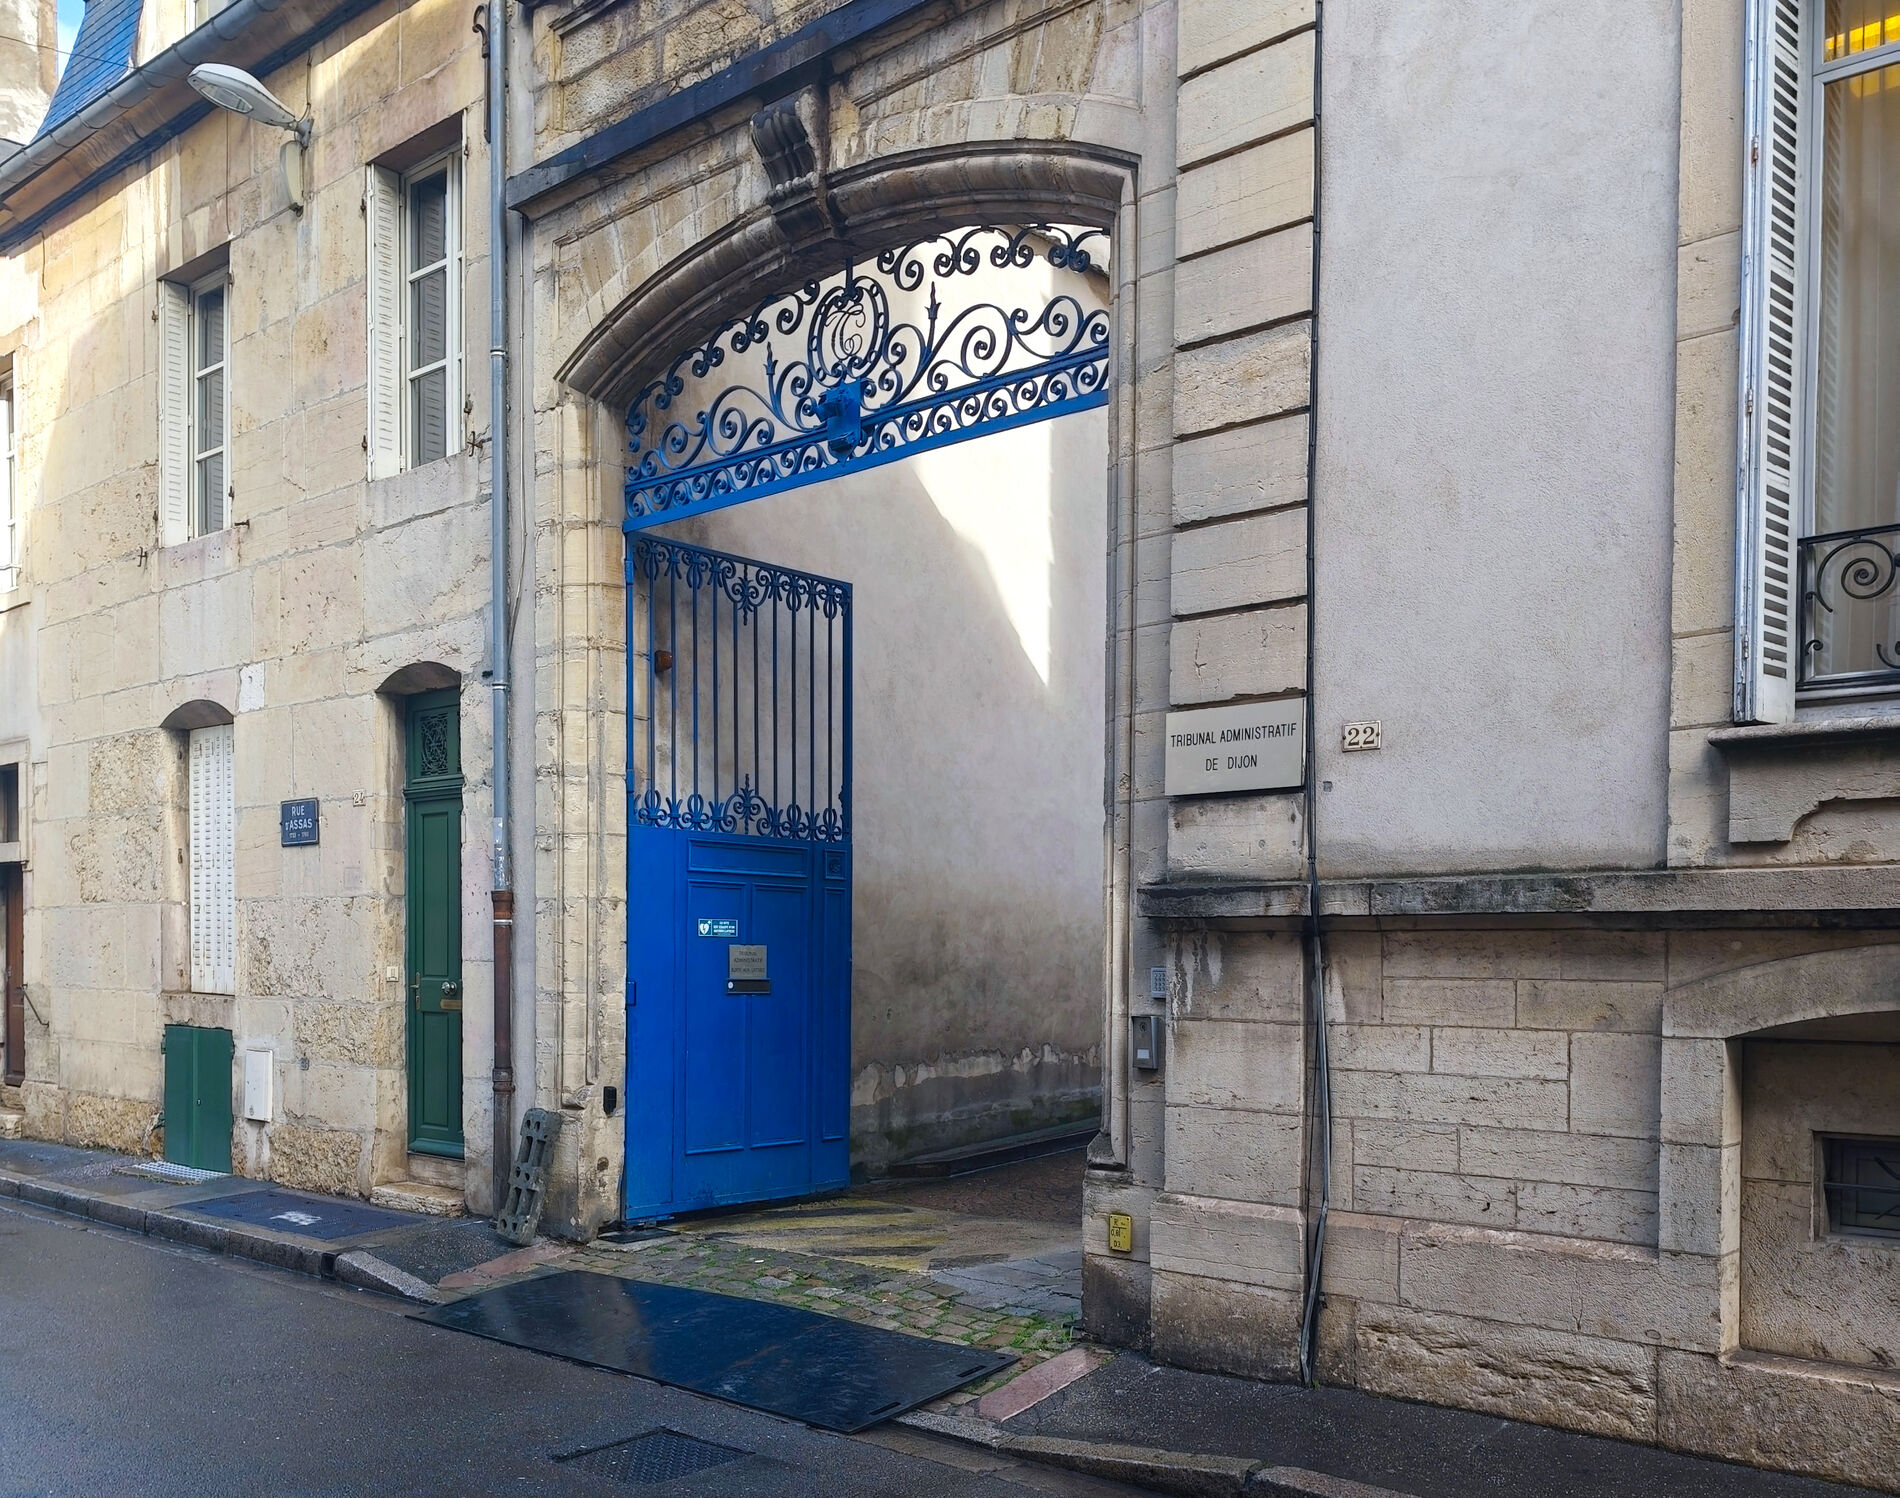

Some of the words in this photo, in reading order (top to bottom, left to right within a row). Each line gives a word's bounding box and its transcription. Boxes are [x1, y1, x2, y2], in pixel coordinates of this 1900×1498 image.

[1171, 732, 1217, 748] TRIBUNAL
[1220, 723, 1297, 744] ADMINISTRATIF
[1347, 726, 1376, 747] 22
[1205, 757, 1219, 772] DE
[1227, 755, 1258, 770] DIJON
[291, 805, 305, 816] RUE
